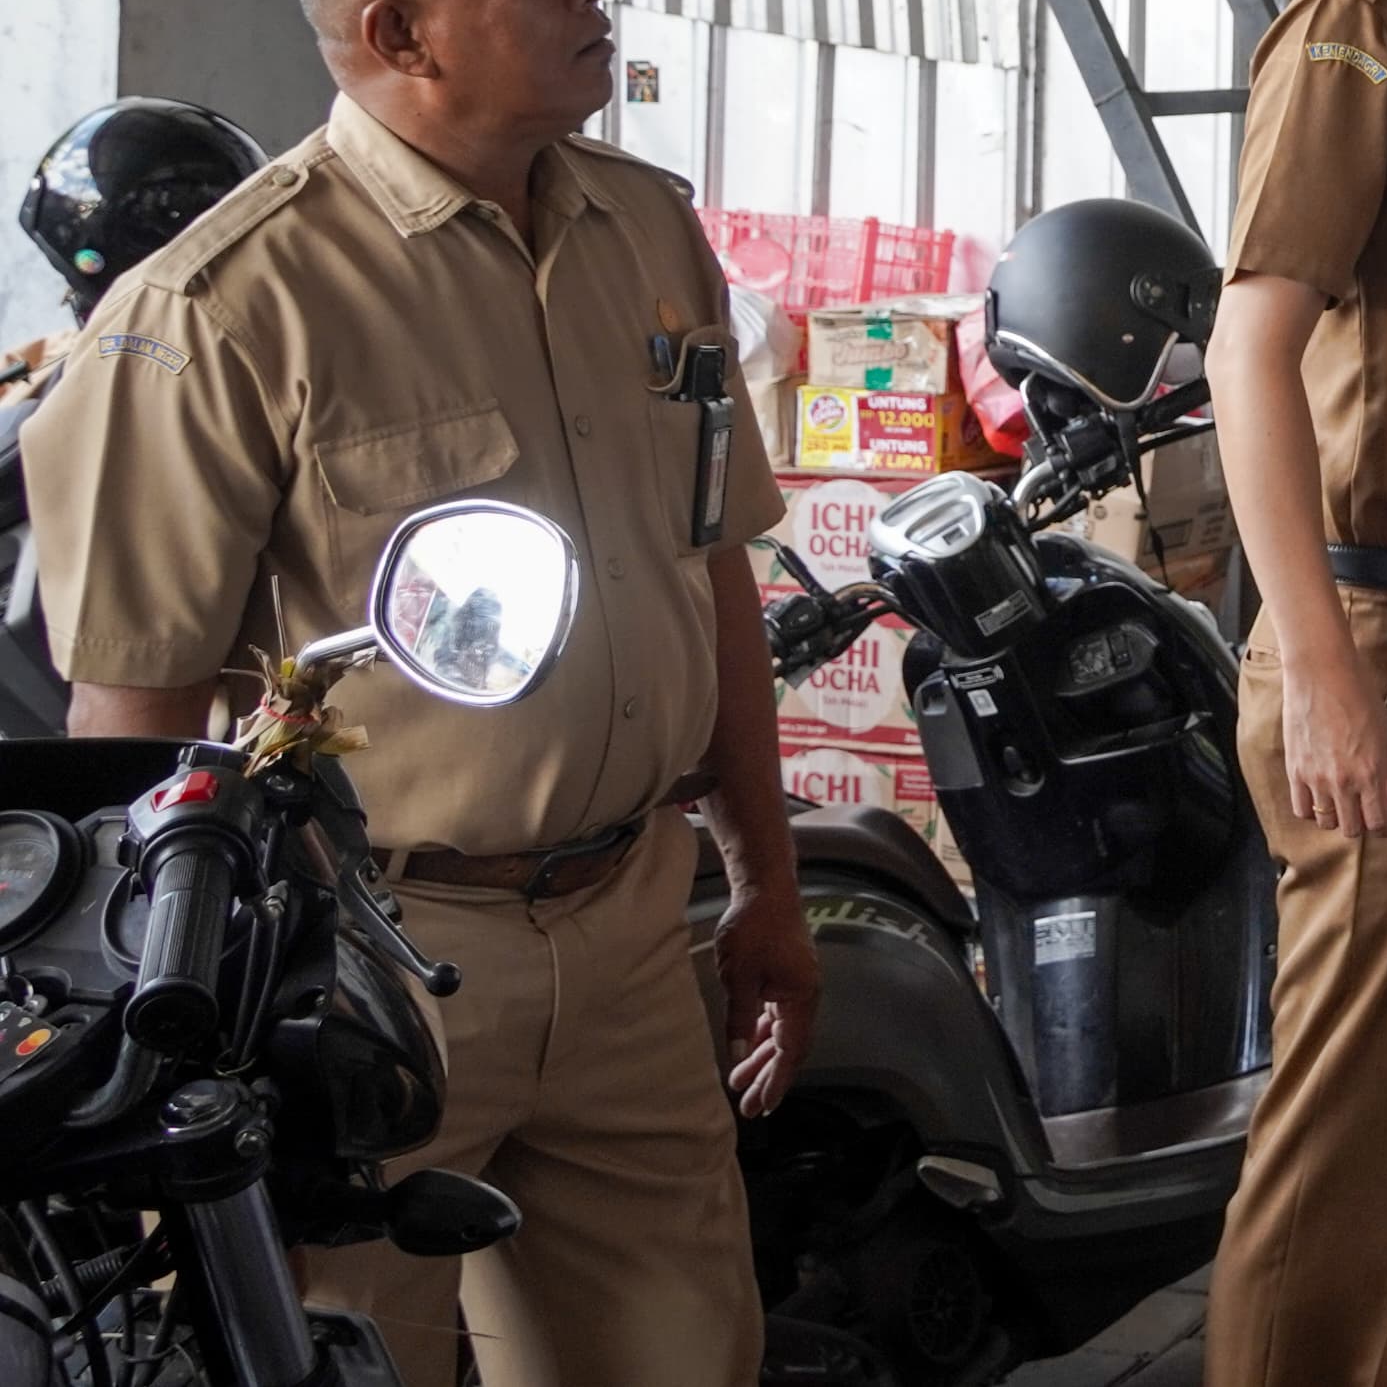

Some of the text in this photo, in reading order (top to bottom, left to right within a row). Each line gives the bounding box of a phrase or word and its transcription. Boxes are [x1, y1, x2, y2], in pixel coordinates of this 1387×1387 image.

[866, 395, 928, 412] UNTUNG
[878, 410, 936, 429] 12.000
[868, 437, 929, 455] UNTUNG
[811, 502, 876, 533] ICHI
[809, 533, 874, 558] OCHA
[809, 667, 881, 695] OCHA
[792, 770, 862, 804] ICHI
